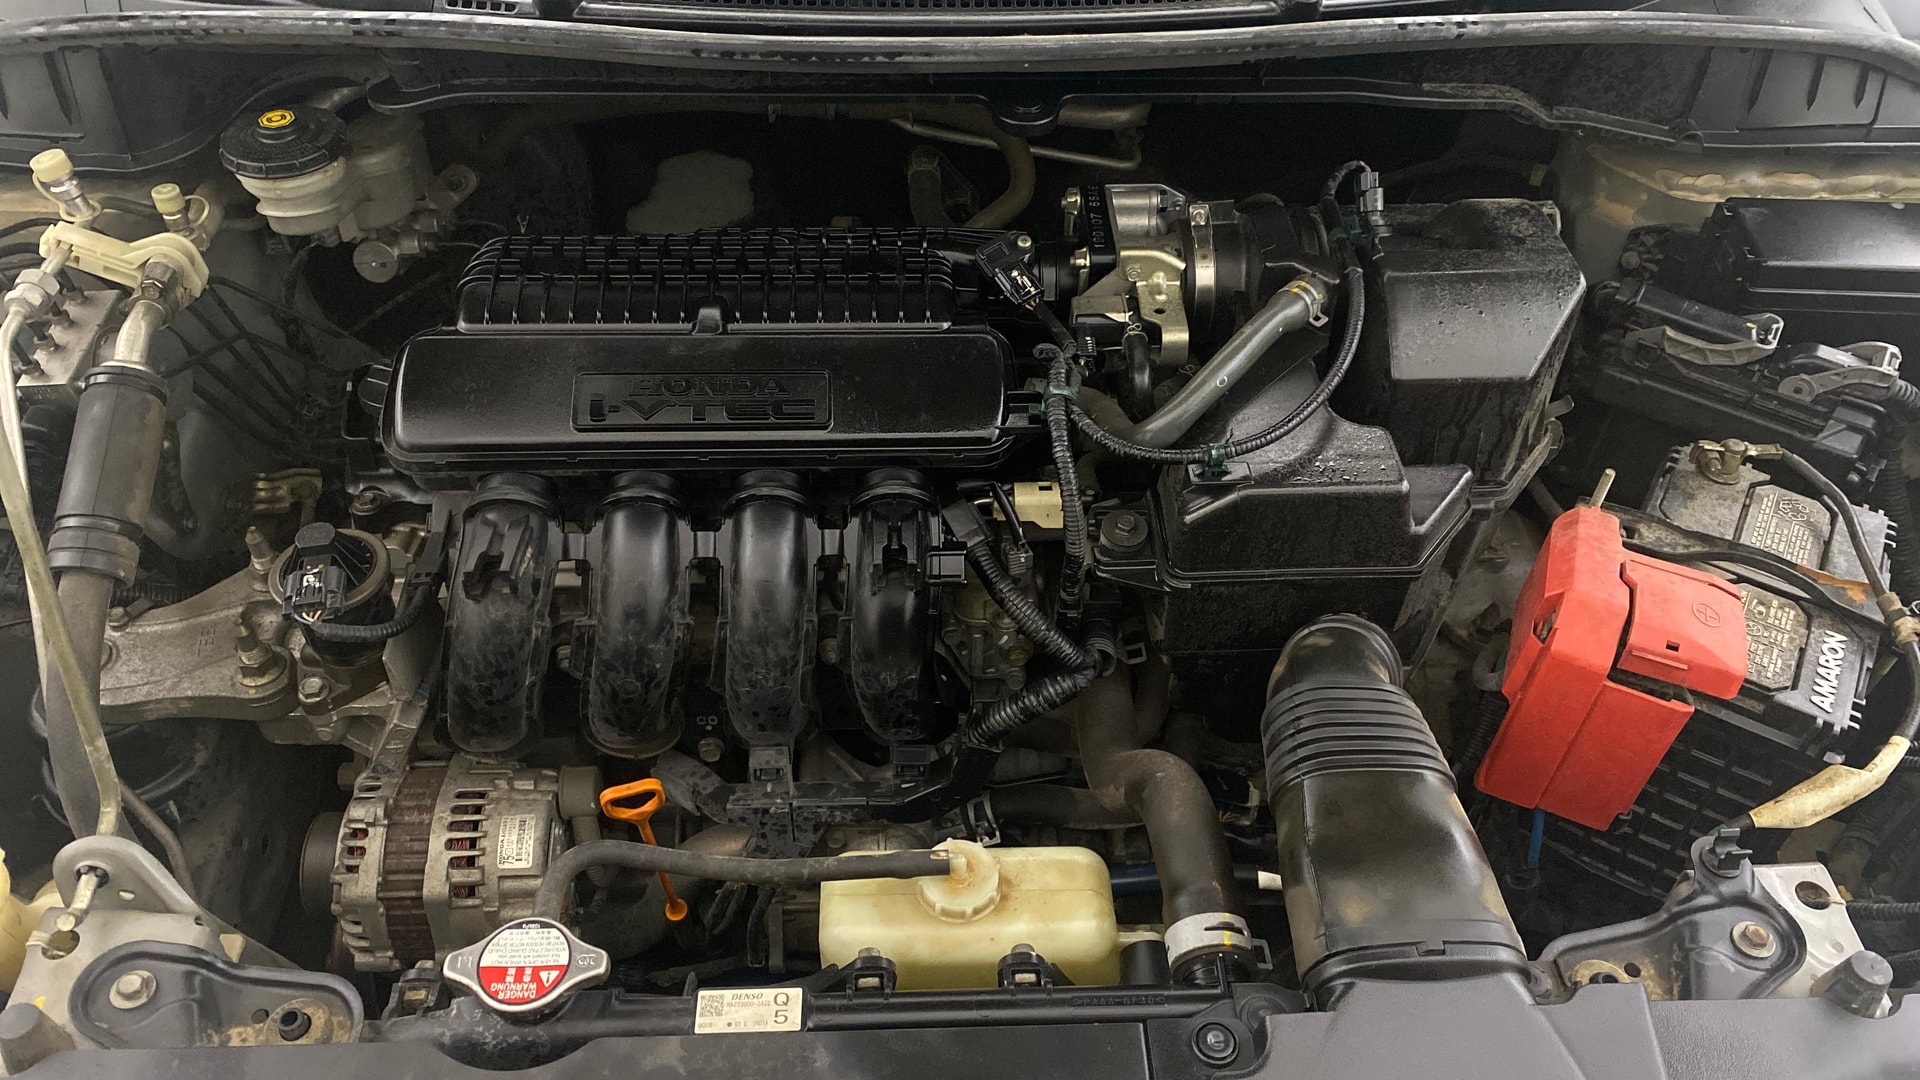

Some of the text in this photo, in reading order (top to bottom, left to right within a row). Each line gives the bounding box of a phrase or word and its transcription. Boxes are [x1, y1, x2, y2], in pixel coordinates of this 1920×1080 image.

[628, 376, 792, 397] HONDA
[589, 393, 816, 422] i-VTEC
[1809, 630, 1849, 713] AMARON
[490, 982, 537, 991] WARNUNG
[498, 990, 536, 1000] DANGER
[731, 992, 790, 1006] DENSO Q
[773, 1009, 788, 1024] 5
